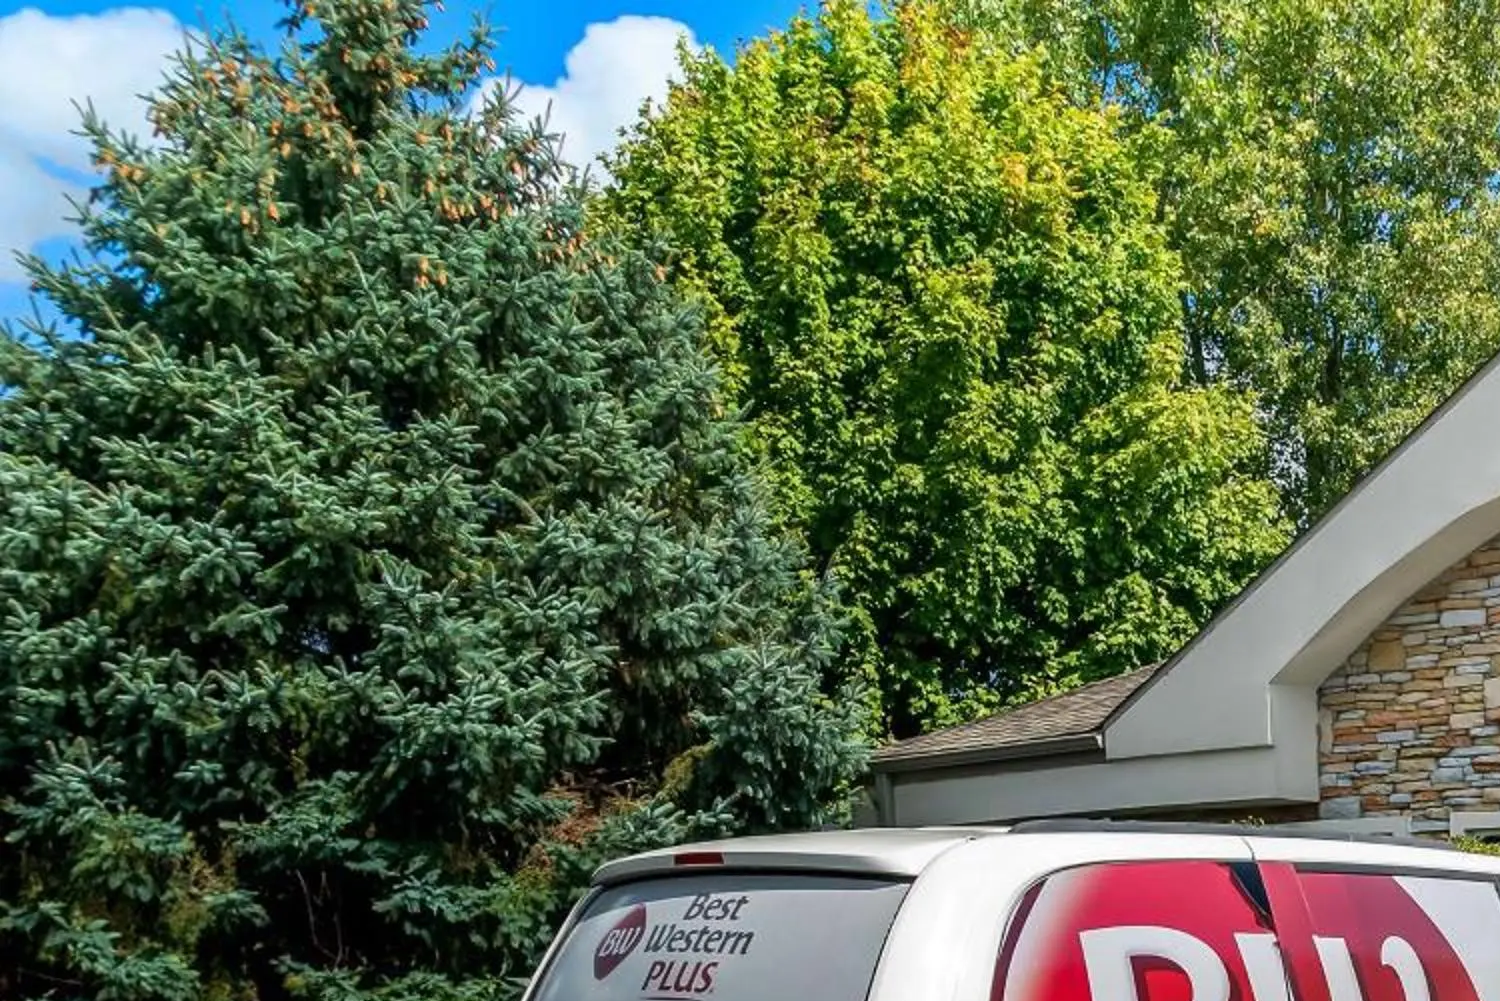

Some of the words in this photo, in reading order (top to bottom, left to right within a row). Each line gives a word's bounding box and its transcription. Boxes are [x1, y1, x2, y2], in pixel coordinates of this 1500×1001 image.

[683, 894, 750, 921] Best
[599, 927, 639, 957] BW
[644, 924, 754, 955] Western
[641, 960, 718, 993] PLUS
